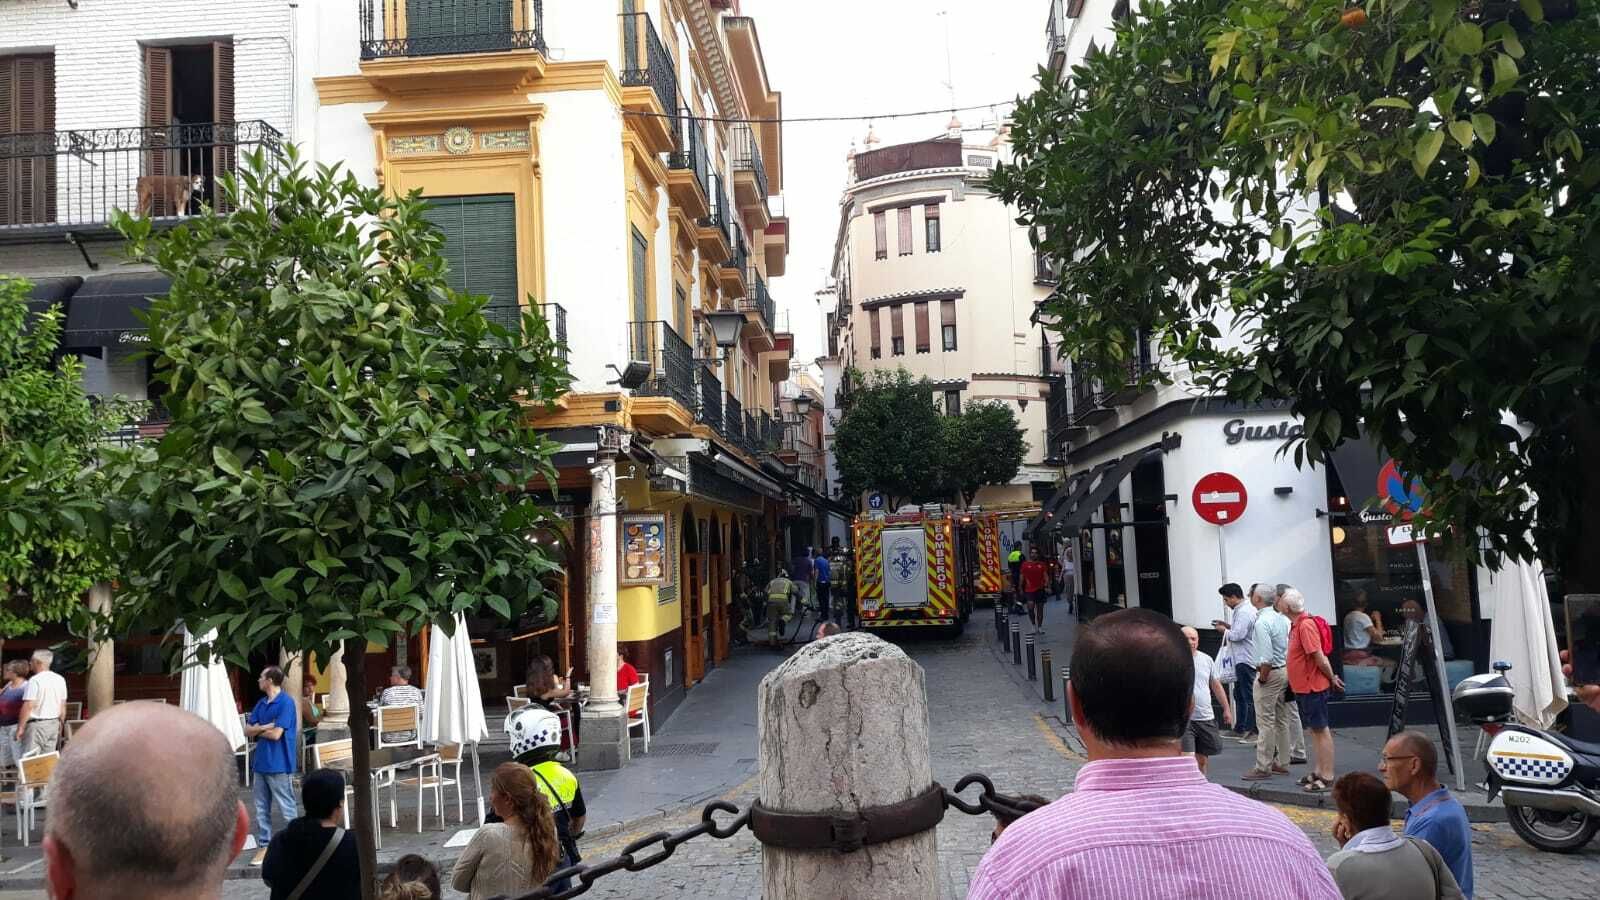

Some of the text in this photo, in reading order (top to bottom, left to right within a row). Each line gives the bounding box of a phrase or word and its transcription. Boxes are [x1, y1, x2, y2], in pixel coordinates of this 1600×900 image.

[1223, 419, 1304, 445] Gusto
[1360, 507, 1393, 523] Gusto
[934, 522, 946, 590] BOMBEROS
[1508, 735, 1531, 744] M202
